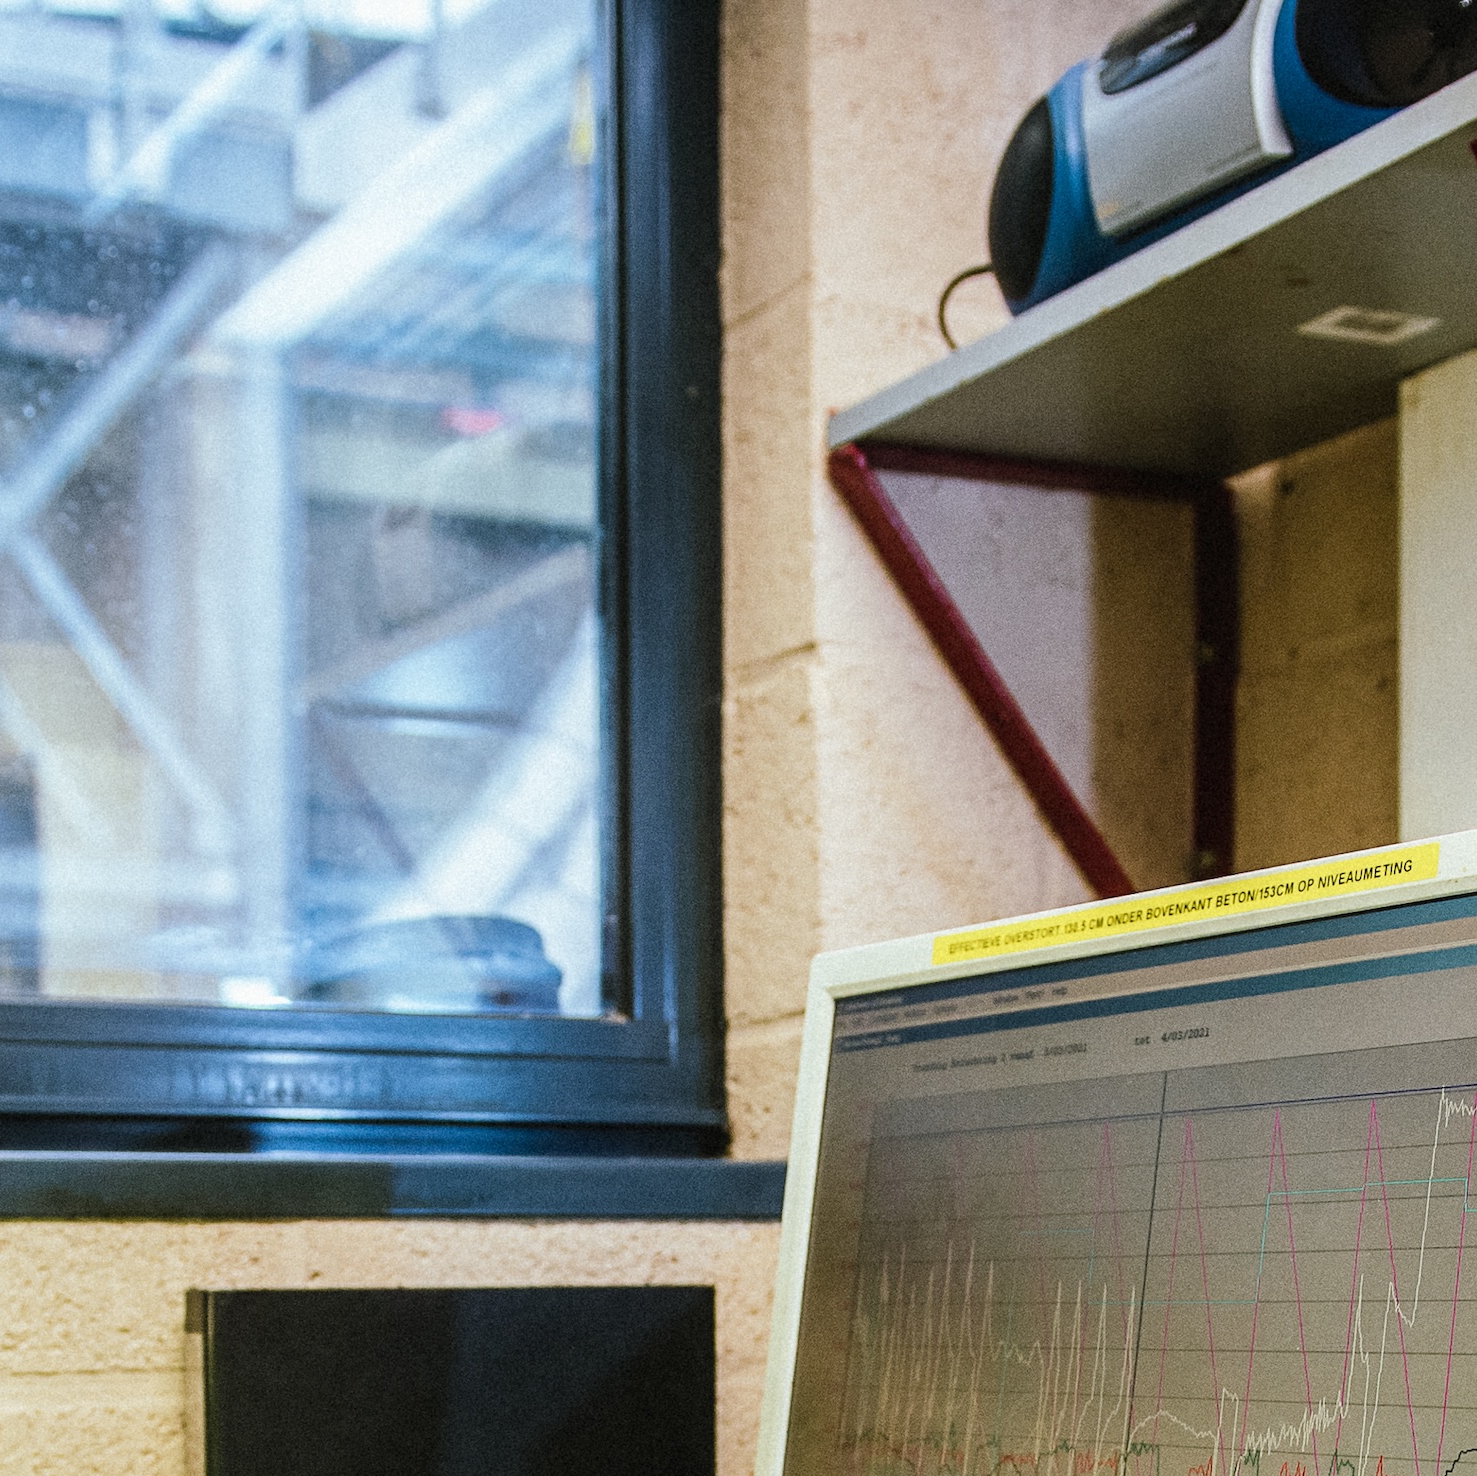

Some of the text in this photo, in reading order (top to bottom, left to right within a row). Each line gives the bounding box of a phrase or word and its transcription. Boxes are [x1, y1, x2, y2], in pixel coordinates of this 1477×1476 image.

[1089, 917, 1103, 929] CM
[1106, 910, 1142, 926] ONDER
[1146, 897, 1212, 919] BOVENKANT
[1215, 881, 1294, 907] BETON/153CM
[1297, 878, 1314, 892] OP
[1318, 859, 1412, 888] NIVEAUMETING
[1134, 1035, 1151, 1046] tot
[1160, 1027, 1211, 1043] 4/03/2021
